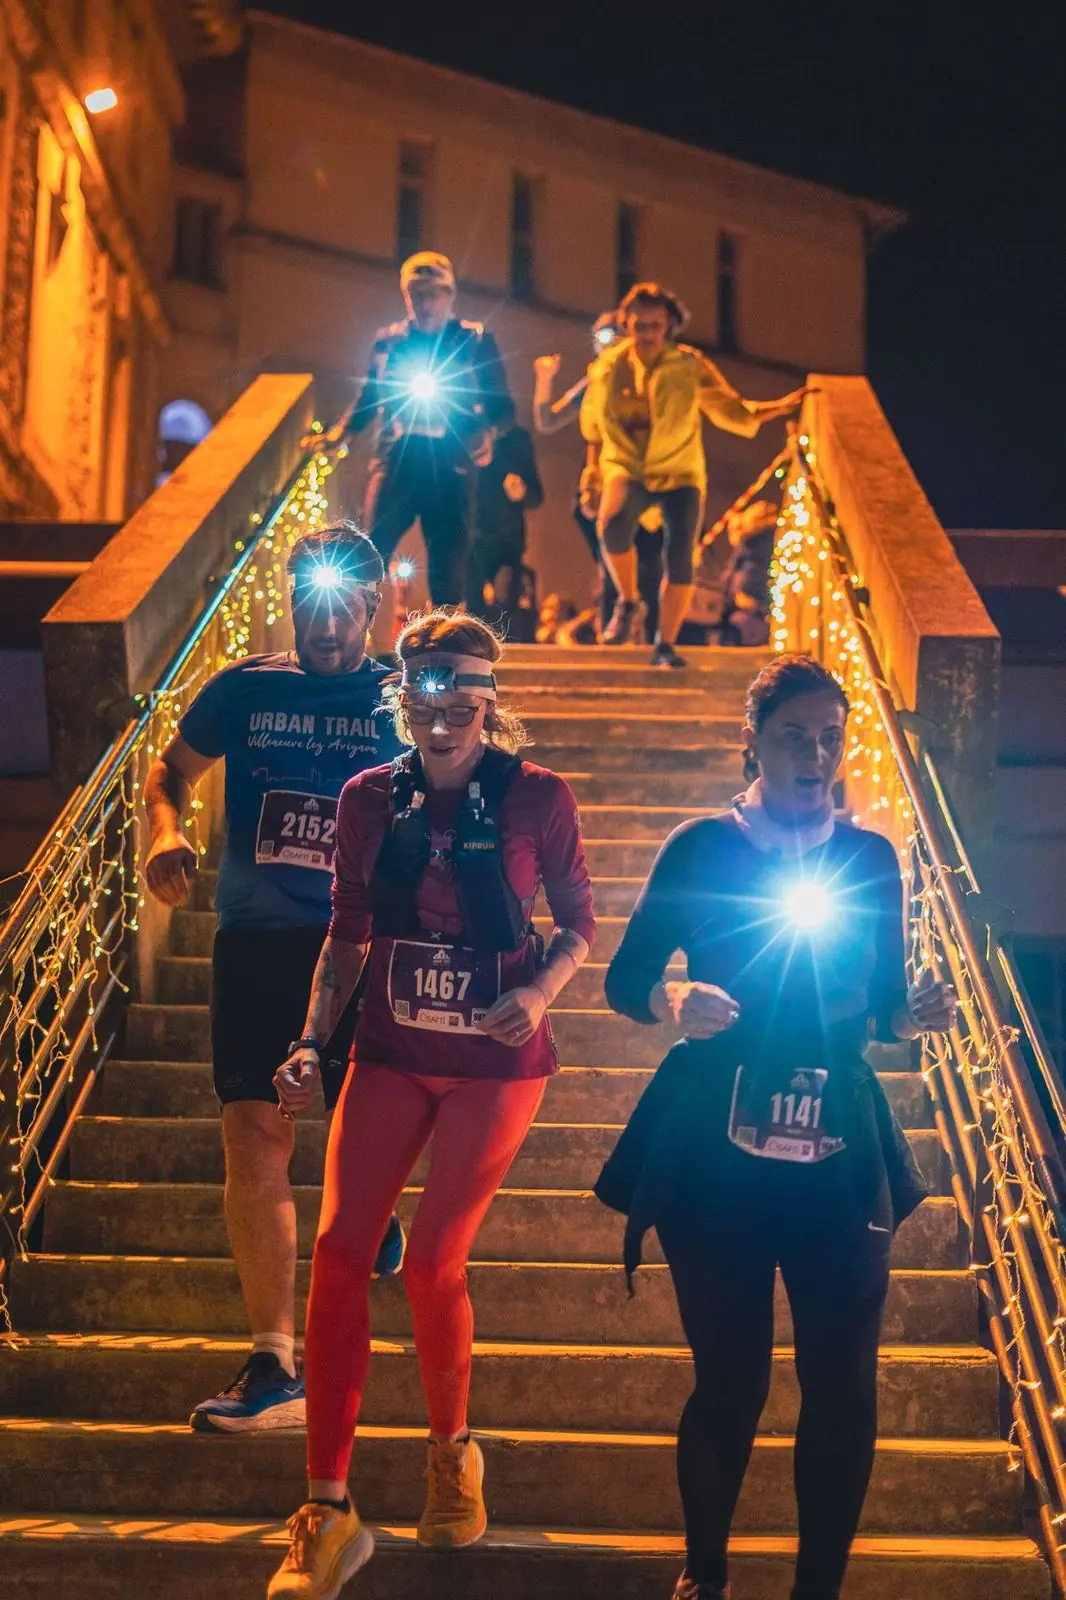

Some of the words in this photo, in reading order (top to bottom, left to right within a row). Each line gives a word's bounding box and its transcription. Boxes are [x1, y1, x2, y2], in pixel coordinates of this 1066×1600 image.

[250, 712, 315, 734] URBAN
[324, 716, 381, 740] TRAIL
[247, 731, 304, 749] Villeneuve
[306, 736, 324, 756] lez
[327, 738, 378, 758] Avignon
[280, 811, 336, 844] 2152
[463, 841, 495, 850] KIPRUN
[414, 967, 472, 1001] 1467
[771, 1092, 822, 1129] 1141
